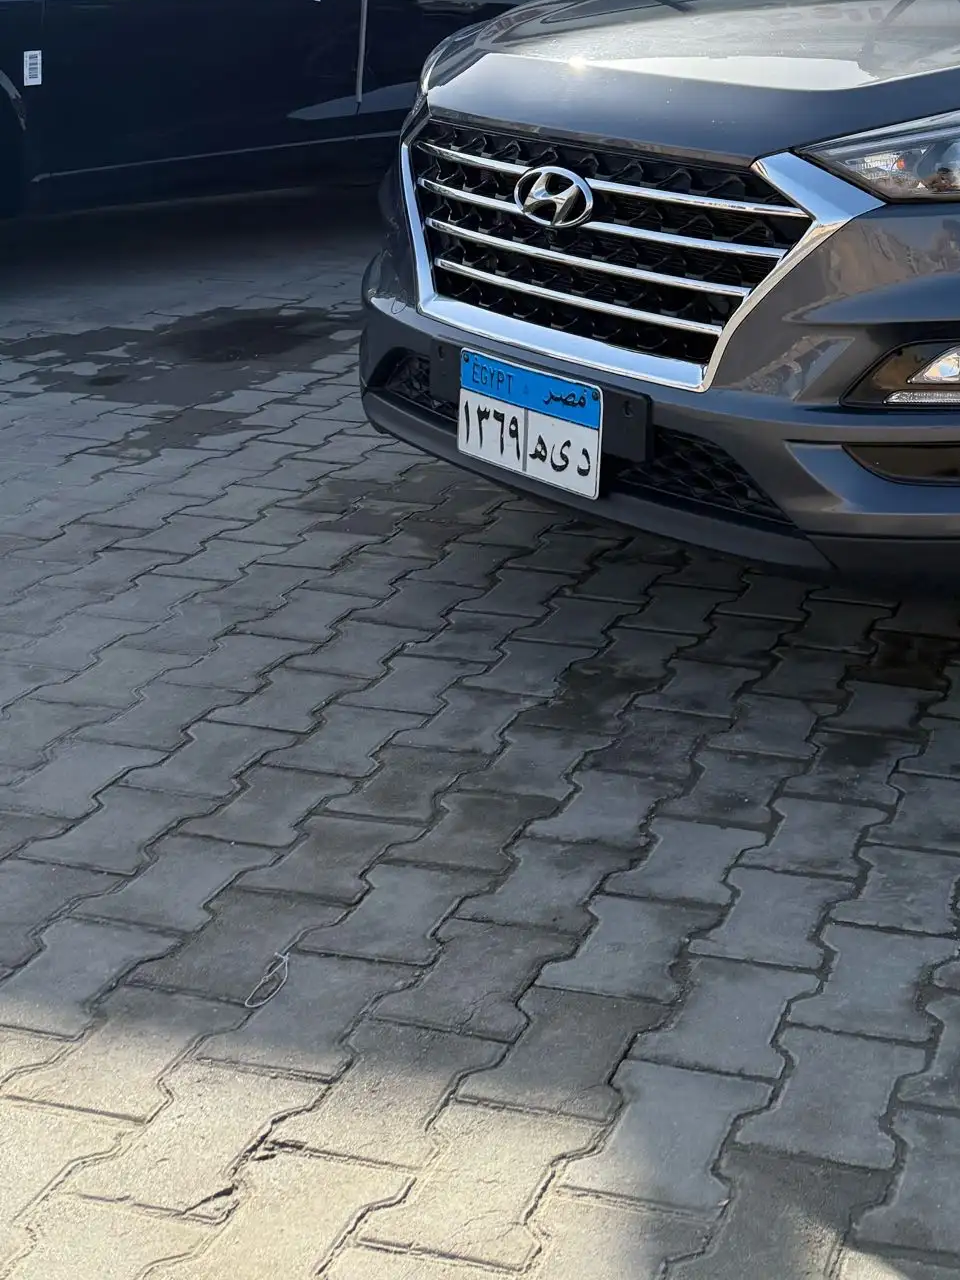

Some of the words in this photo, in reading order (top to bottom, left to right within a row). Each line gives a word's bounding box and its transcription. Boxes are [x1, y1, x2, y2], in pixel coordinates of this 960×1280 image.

[471, 362, 515, 395] EGYPT
[543, 388, 588, 409] مصر
[463, 399, 521, 461] ١٣٦٩
